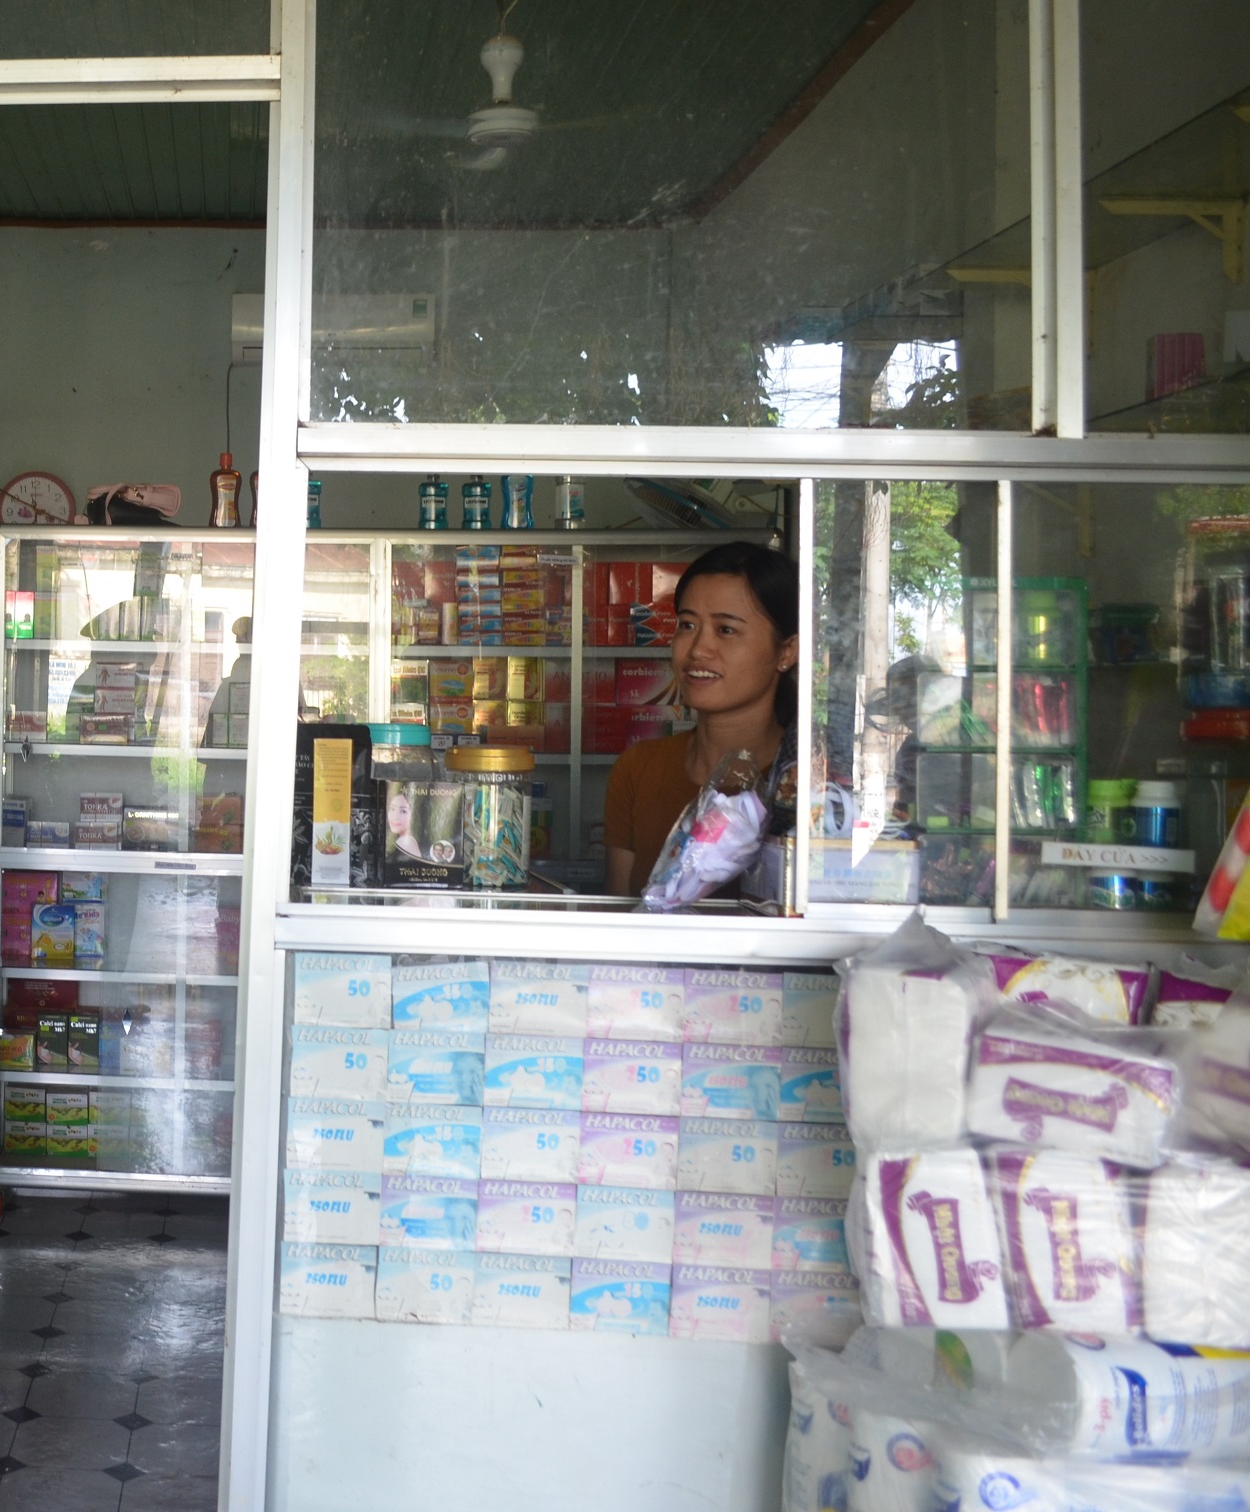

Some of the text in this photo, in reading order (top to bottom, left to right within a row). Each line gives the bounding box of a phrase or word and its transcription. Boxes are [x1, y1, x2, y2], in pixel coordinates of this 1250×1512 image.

[20, 485, 27, 493] 11
[31, 481, 40, 489] 12
[55, 494, 62, 502] 2
[7, 508, 13, 516] 9
[59, 507, 66, 515] 3
[83, 803, 108, 811] TONKA
[78, 831, 103, 840] TONKA
[300, 956, 377, 972] HAPACOL
[497, 964, 575, 981] HAPACOL
[396, 965, 472, 982] HAPACOL
[591, 966, 669, 983] HAPACOL
[689, 972, 768, 989] HAPACOL
[297, 1029, 372, 1046] HAPACOL
[393, 1031, 471, 1048] HAPACOL
[493, 1037, 567, 1053] HAPACOL
[589, 1042, 667, 1059] HAPACOL
[689, 1045, 766, 1062] HAPACOL
[293, 1101, 368, 1117] HAPACOL
[391, 1105, 465, 1122] HAPACOL
[488, 1108, 565, 1126] HAPACOL
[585, 1114, 663, 1132] HAPACOL
[683, 1120, 760, 1139] HAPACOL
[289, 1172, 365, 1189] HAPACOL
[387, 1177, 463, 1194] HAPACOL
[484, 1182, 561, 1199] HAPACOL
[582, 1188, 660, 1206] HAPACOL
[680, 1194, 759, 1212] HAPACOL
[287, 1243, 363, 1262] HAPACOL
[383, 1251, 458, 1267] HAPACOL
[479, 1255, 556, 1272] HAPACOL
[578, 1260, 656, 1279] HAPACOL
[678, 1266, 757, 1285] HAPACOL
